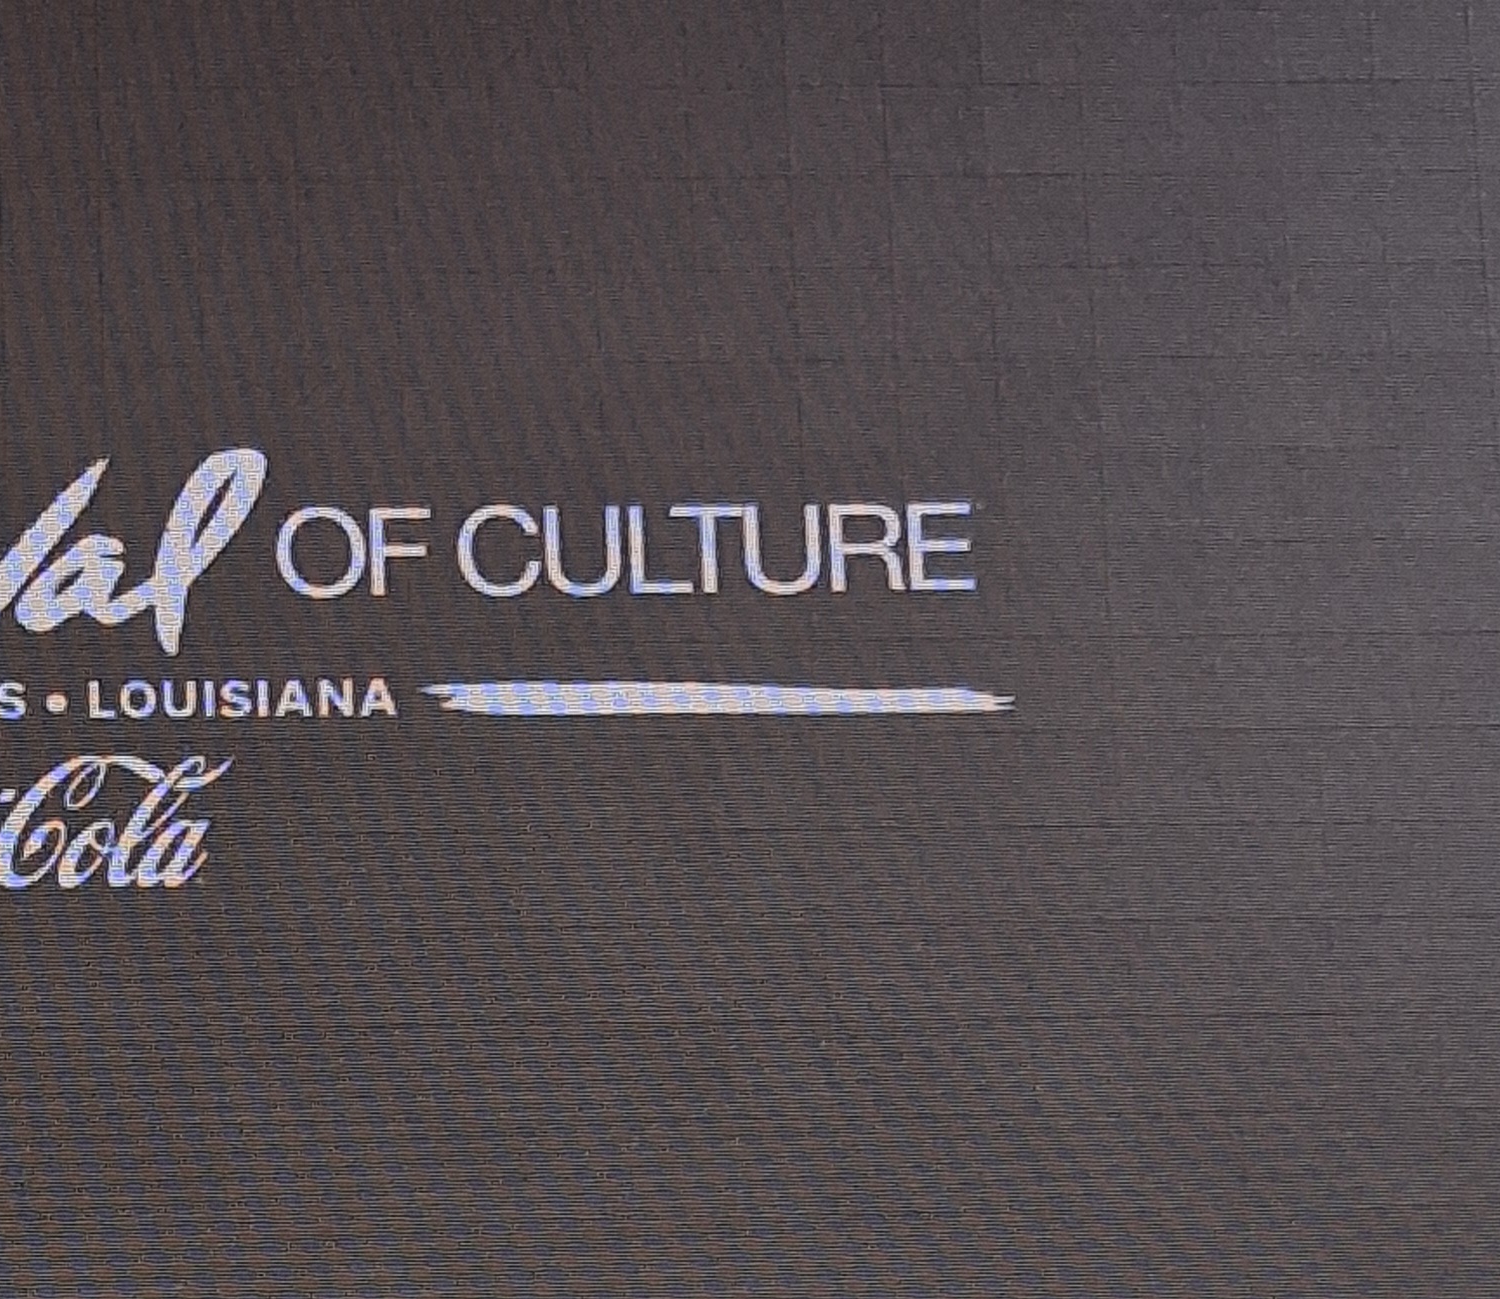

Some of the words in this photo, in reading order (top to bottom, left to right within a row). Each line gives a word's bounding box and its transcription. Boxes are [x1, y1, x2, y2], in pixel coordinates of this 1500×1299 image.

[275, 503, 432, 600] OF
[455, 501, 978, 598] CULTURE
[87, 678, 399, 720] LOUISIANA
